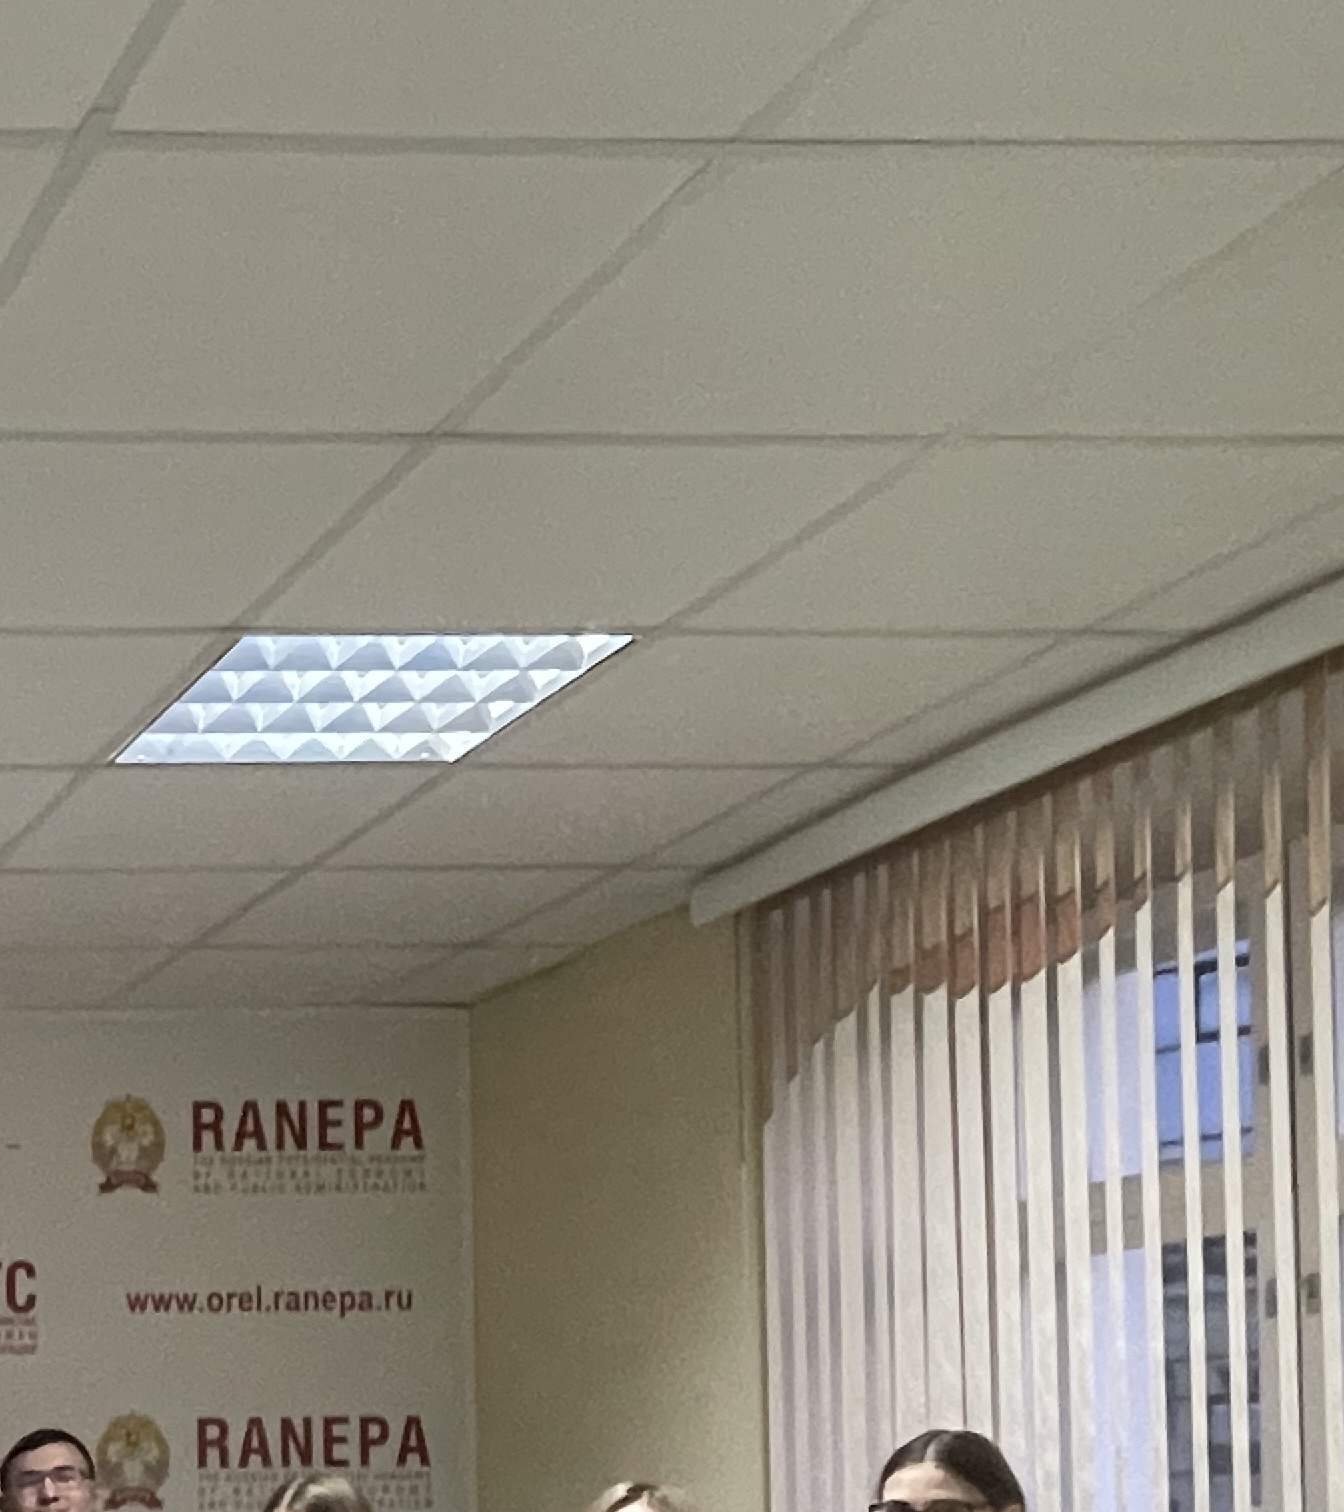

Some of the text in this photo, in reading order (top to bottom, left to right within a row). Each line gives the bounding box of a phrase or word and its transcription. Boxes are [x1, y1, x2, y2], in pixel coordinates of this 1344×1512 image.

[193, 1098, 424, 1152] RANEPA
[126, 1285, 413, 1318] www.orel.ranepa.ru
[196, 1415, 431, 1469] RANEPA
